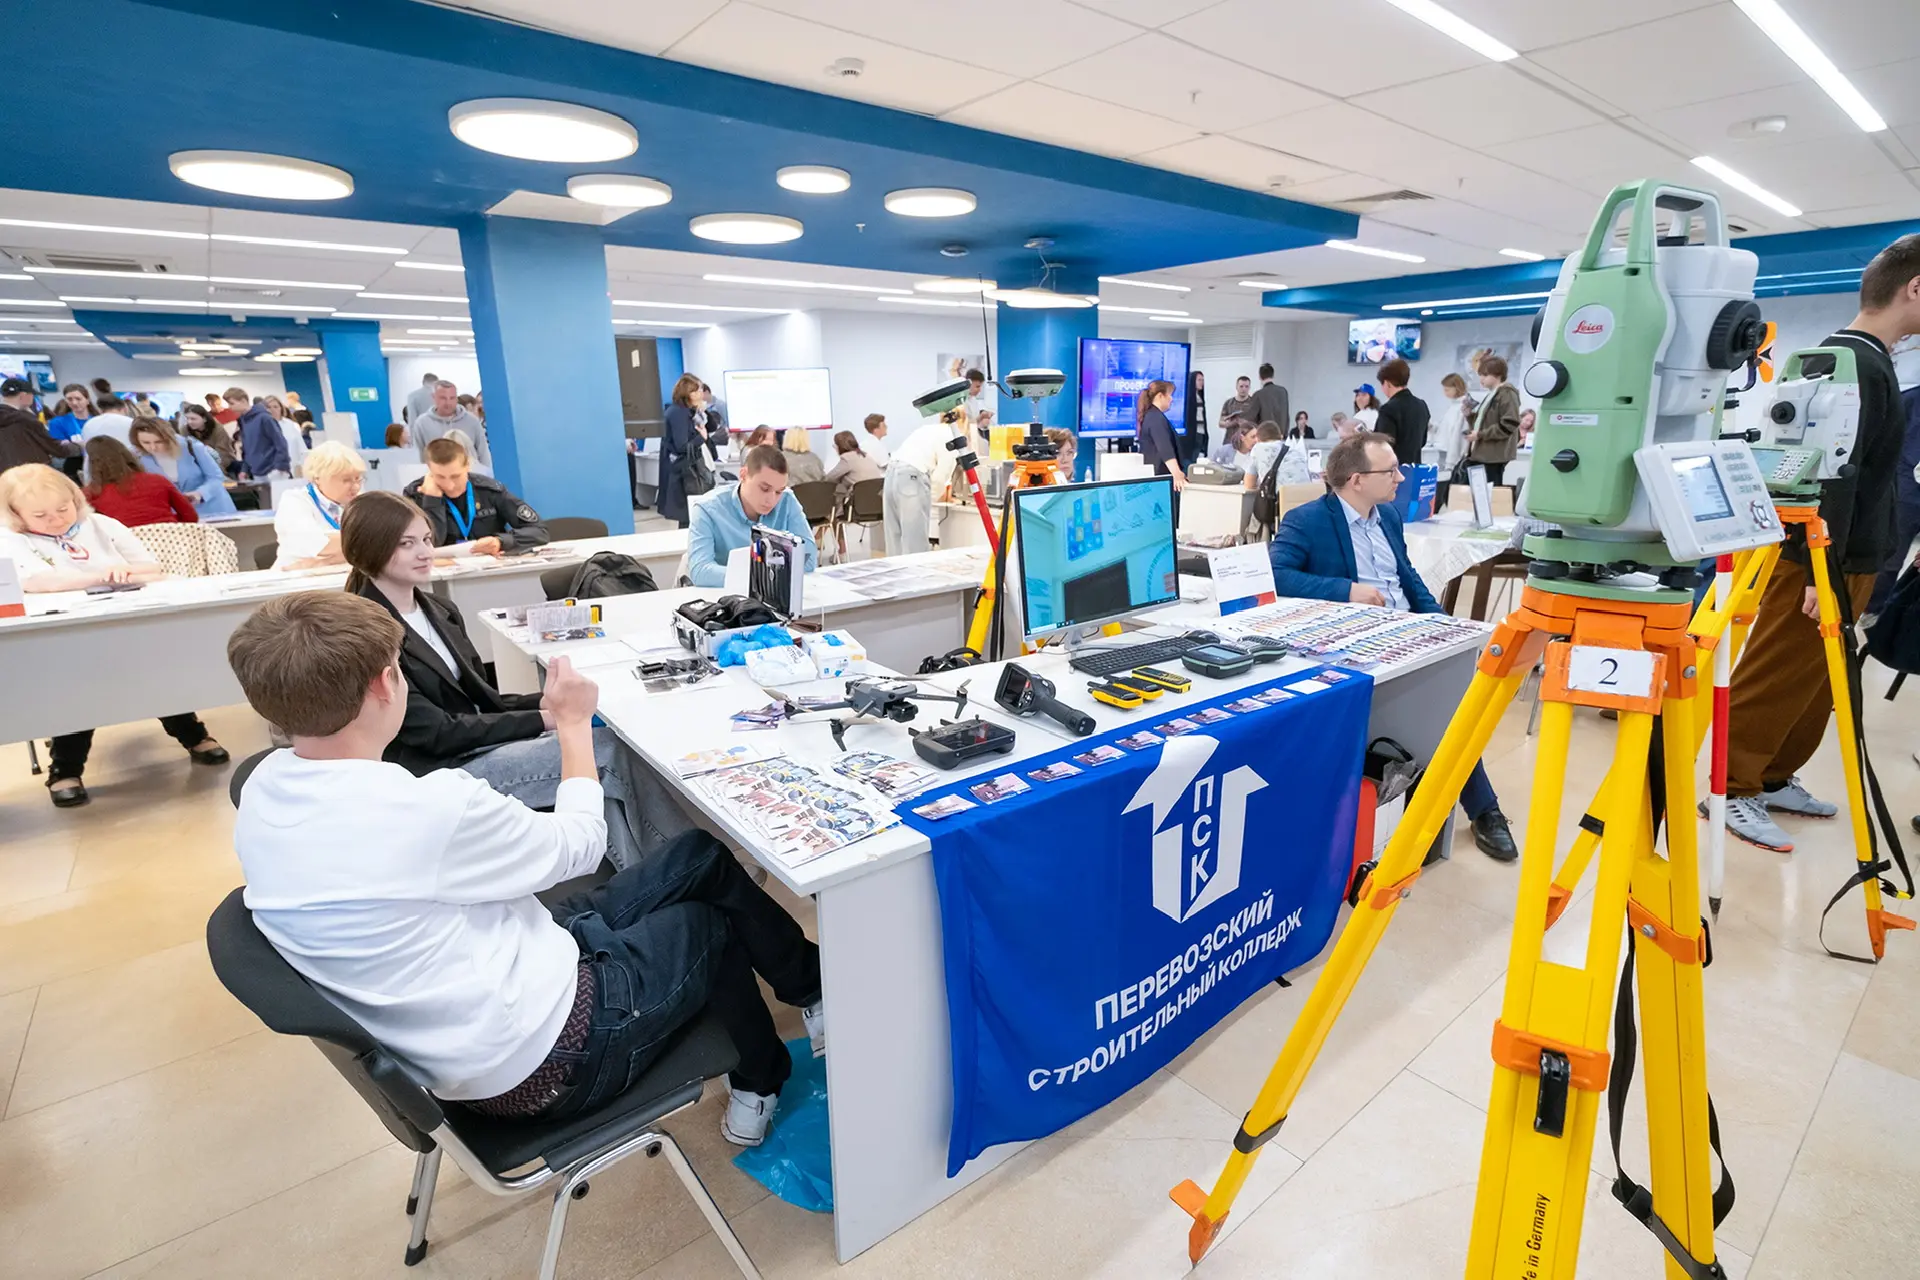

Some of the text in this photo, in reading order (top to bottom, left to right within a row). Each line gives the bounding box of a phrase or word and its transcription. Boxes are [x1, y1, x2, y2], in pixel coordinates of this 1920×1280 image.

[1572, 319, 1604, 335] Leica
[1598, 657, 1618, 685] 2
[1190, 775, 1214, 901] ПСК
[1095, 888, 1274, 1030] ПЕРЕВОЗСКИЙ
[1028, 906, 1303, 1092] СТРОИТЕЛЬНЫЙ КОЛЛЕДЖ
[1526, 1193, 1551, 1251] Germany
[1524, 1254, 1540, 1268] in
